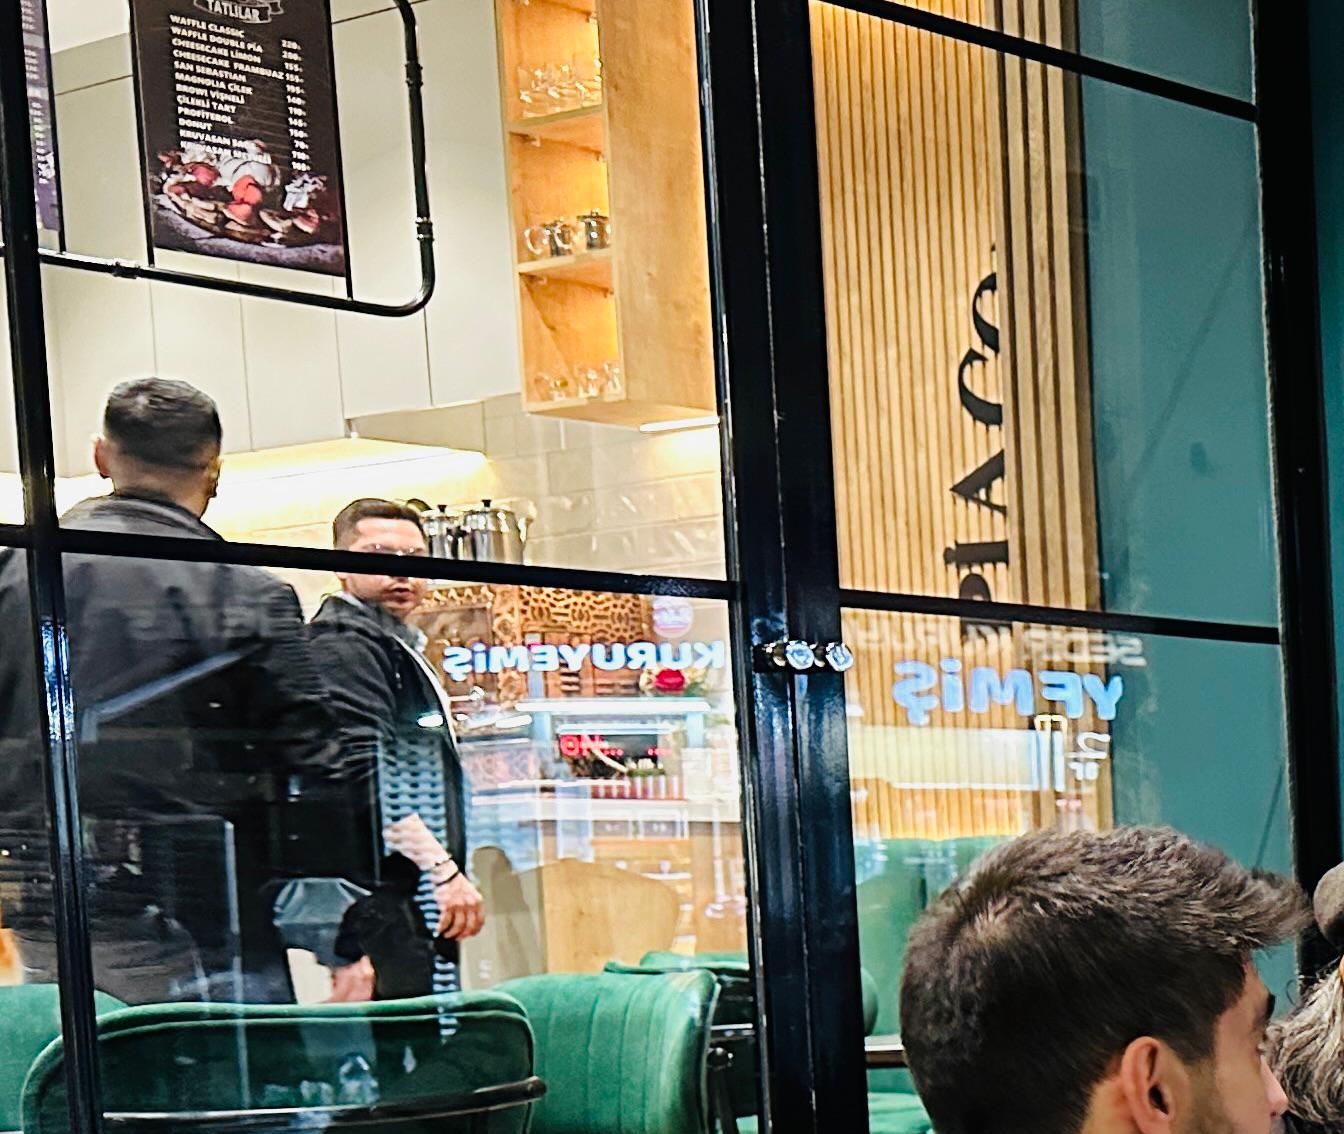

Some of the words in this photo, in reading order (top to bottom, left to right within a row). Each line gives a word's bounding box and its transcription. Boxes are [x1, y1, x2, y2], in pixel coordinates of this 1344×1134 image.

[170, 14, 207, 30] WAFFLE
[207, 23, 245, 38] CLASSIC
[170, 26, 207, 41] WAFFLE
[209, 34, 245, 49] DOUBLE
[171, 38, 229, 57] CHEESECAKE
[173, 49, 230, 68] CHEESECAKE
